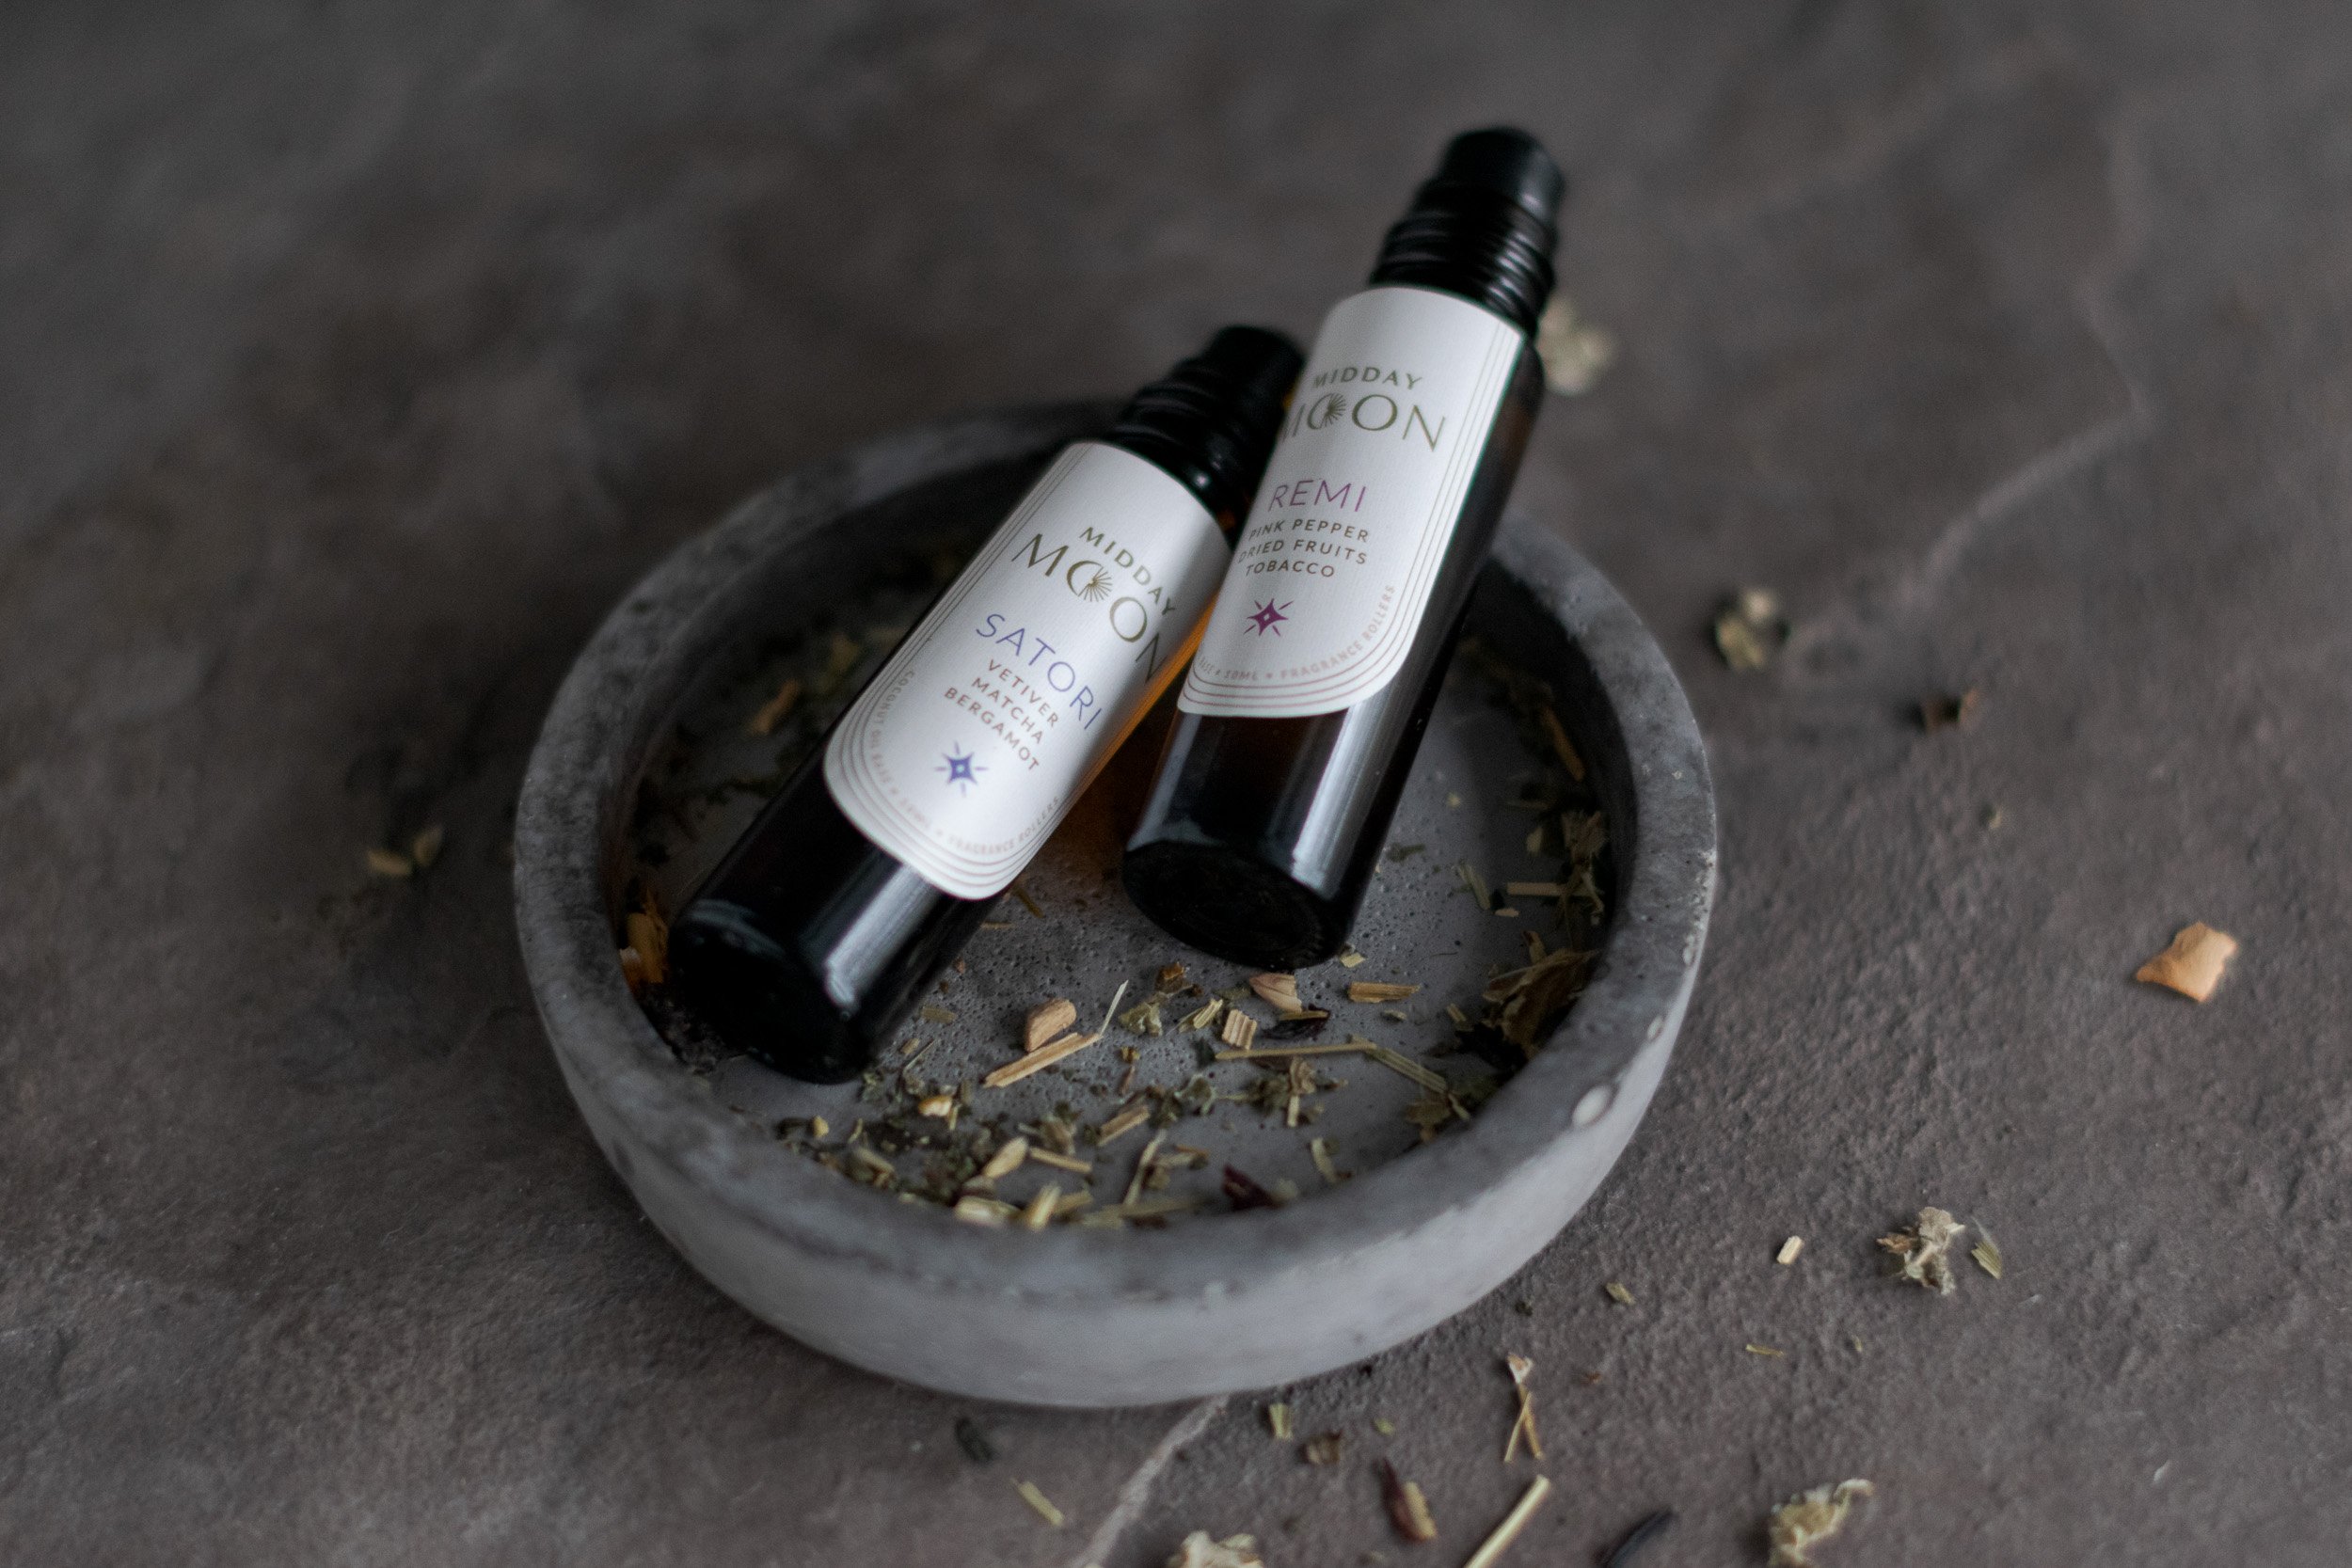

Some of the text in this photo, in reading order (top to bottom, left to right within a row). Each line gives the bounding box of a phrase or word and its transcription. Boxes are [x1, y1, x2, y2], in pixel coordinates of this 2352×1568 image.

[1312, 366, 1422, 390] MIDDAY
[1267, 479, 1367, 513] REMI
[1237, 538, 1368, 565] DRIED FRUITS
[1248, 518, 1369, 544] PINK PEPPER
[1078, 526, 1176, 616] MIDDAY
[1246, 560, 1335, 578] TOBACCO
[1010, 532, 1168, 685] MOON
[1279, 641, 1363, 679] FRAGRANCE
[1361, 584, 1396, 642] ROLLERS
[976, 613, 1103, 731] SATORI
[988, 658, 1059, 728] VETIVER
[944, 687, 1041, 771] BERGAMOT
[971, 676, 1043, 745] MATCHA
